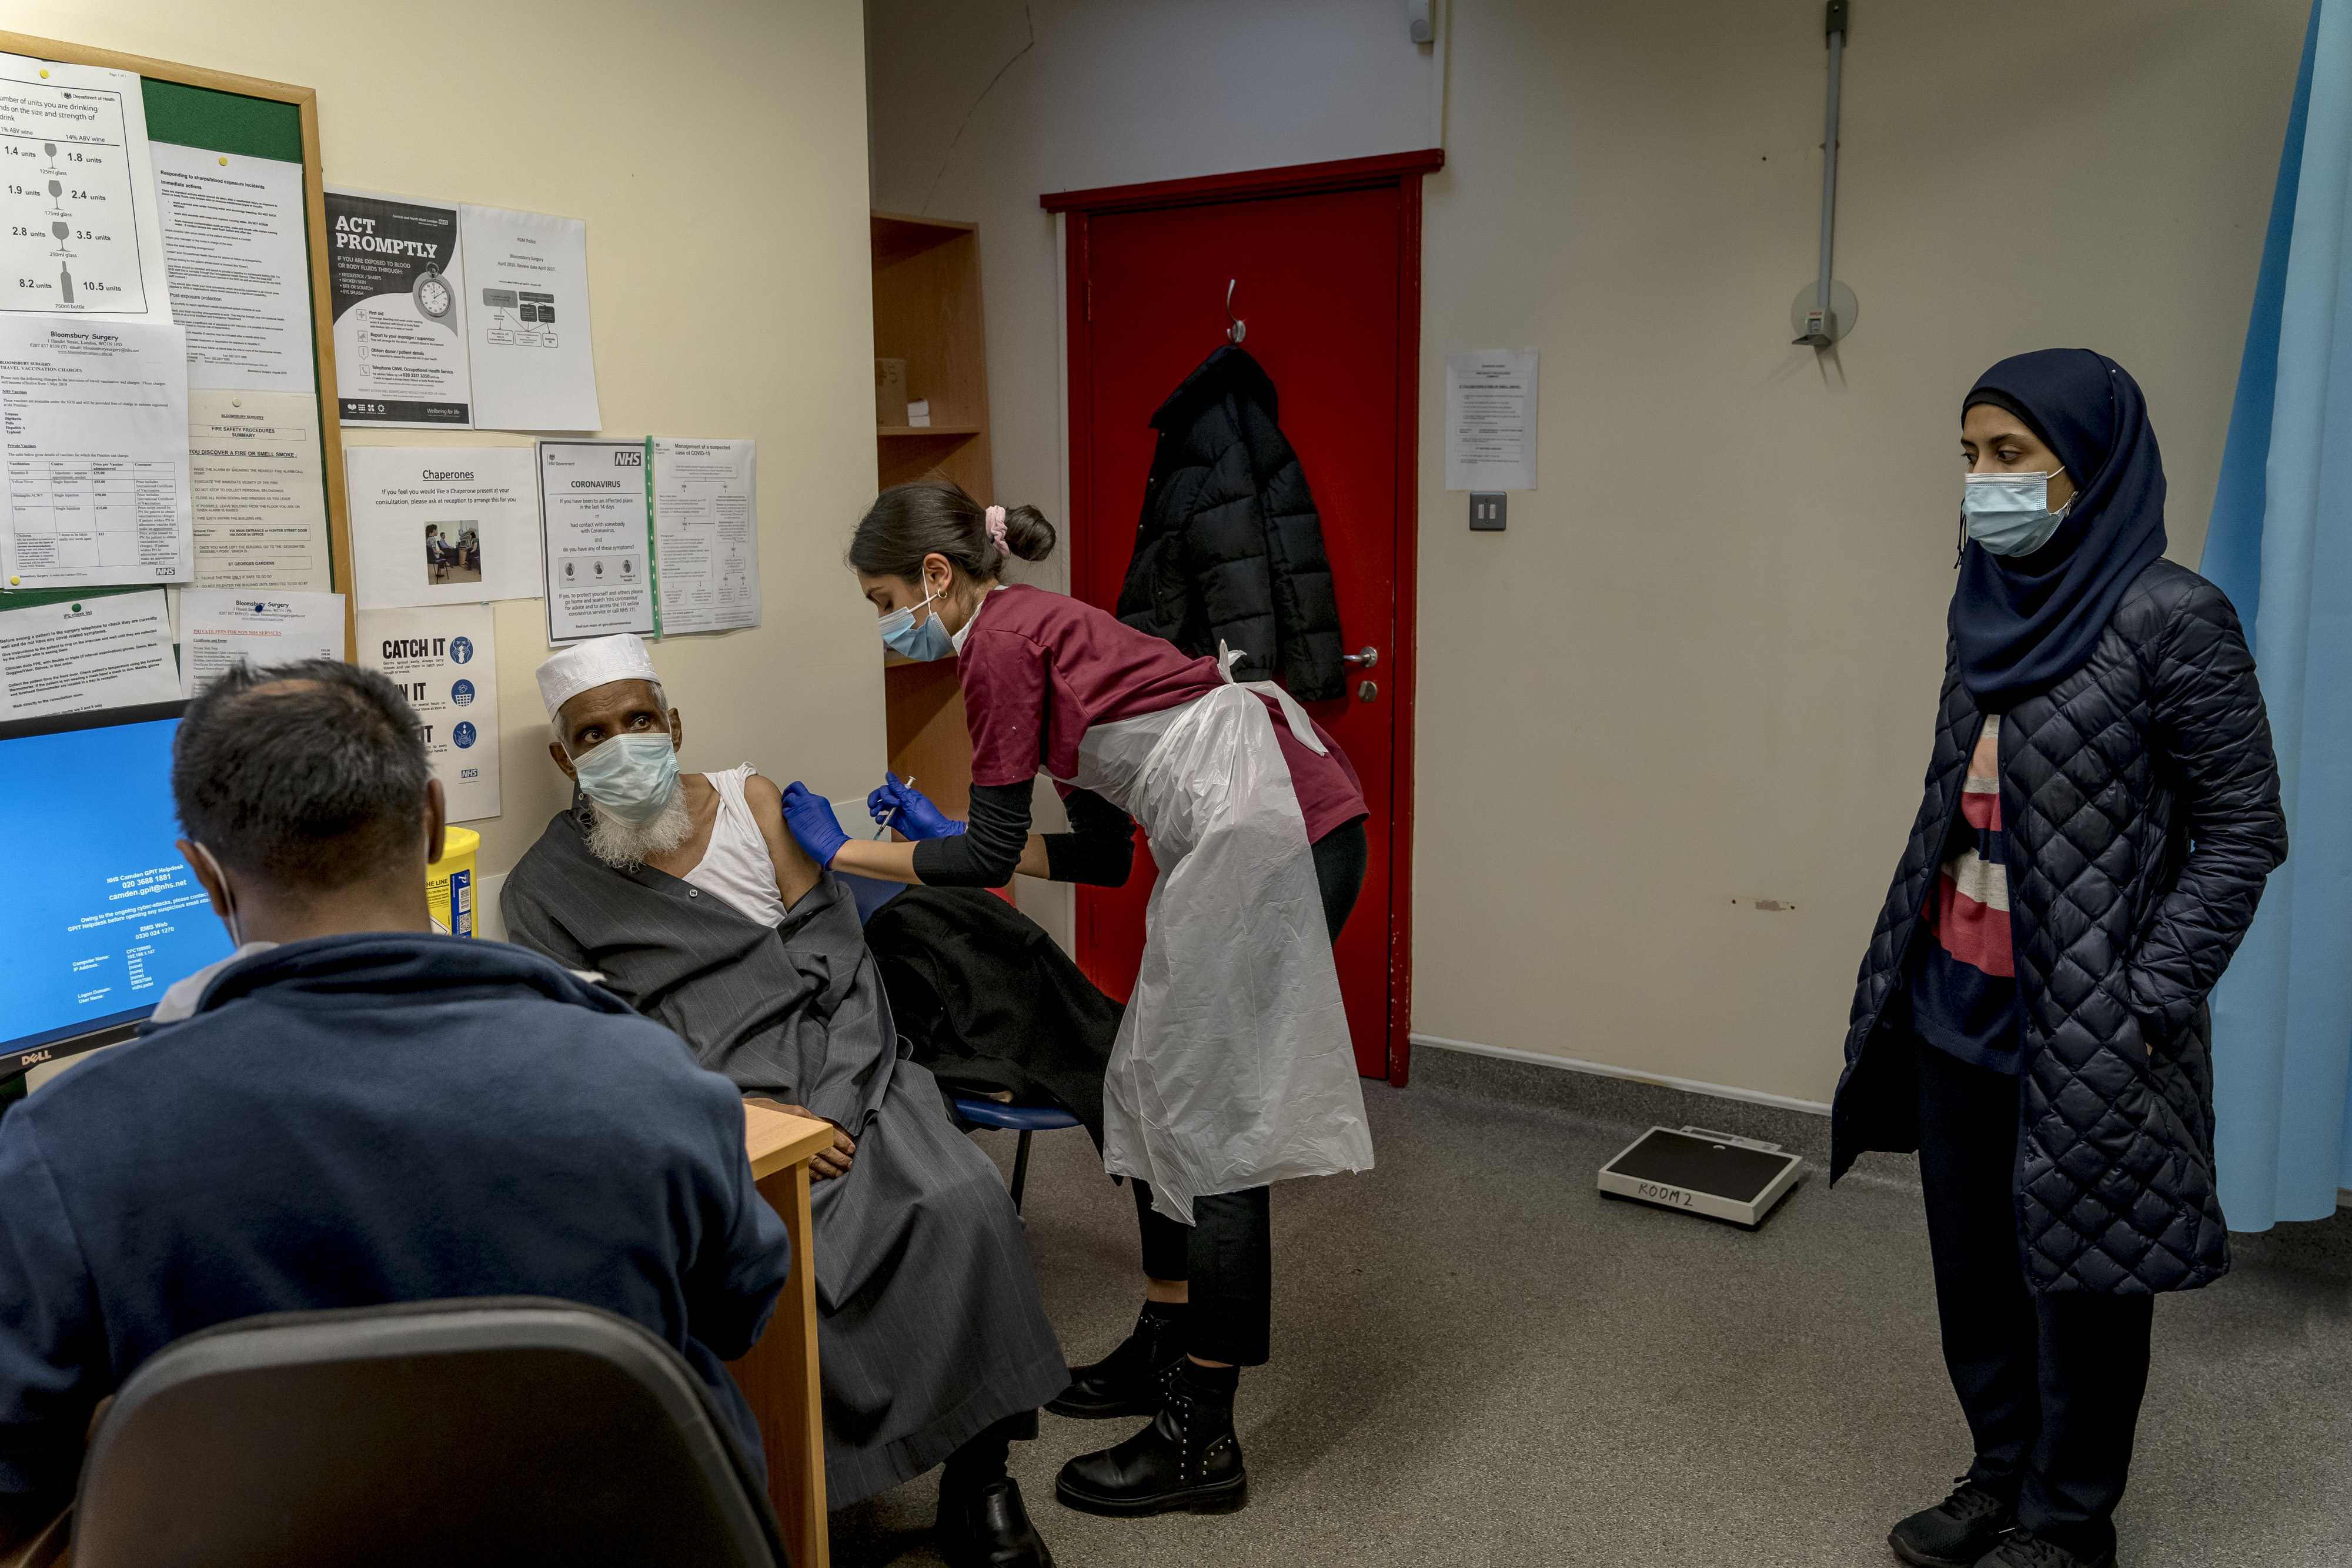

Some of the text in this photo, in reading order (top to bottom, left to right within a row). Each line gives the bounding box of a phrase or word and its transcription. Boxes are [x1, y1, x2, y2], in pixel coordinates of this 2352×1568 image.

[69, 103, 98, 113] drinking
[58, 112, 86, 121] strength
[4, 145, 18, 155] 1.4
[67, 152, 82, 162] 1.8
[160, 170, 188, 179] Responding
[194, 175, 223, 183] sharps/blood
[8, 185, 22, 195] 1.9
[71, 190, 87, 199] 2.4
[335, 216, 375, 234] ACT
[12, 226, 27, 236] 2.8
[76, 230, 92, 239] 3.5
[336, 232, 437, 258] PROMPTLY
[19, 279, 34, 287] 8.2
[83, 282, 104, 290] 10.5
[51, 331, 119, 342] Bloomsbury Surgery
[615, 453, 640, 465] NHS
[423, 470, 474, 480] Chaperones
[382, 638, 446, 659] CATCH IT
[413, 682, 426, 701] IT
[420, 725, 433, 743] IT
[120, 872, 143, 881] Camden
[158, 864, 184, 873] Helpdesk
[122, 873, 171, 888] 020 3688 1881
[109, 879, 187, 900] camden.gpit@nhs.net
[21, 1050, 51, 1065] DELL
[1638, 1183, 1693, 1206] ROOM 2
